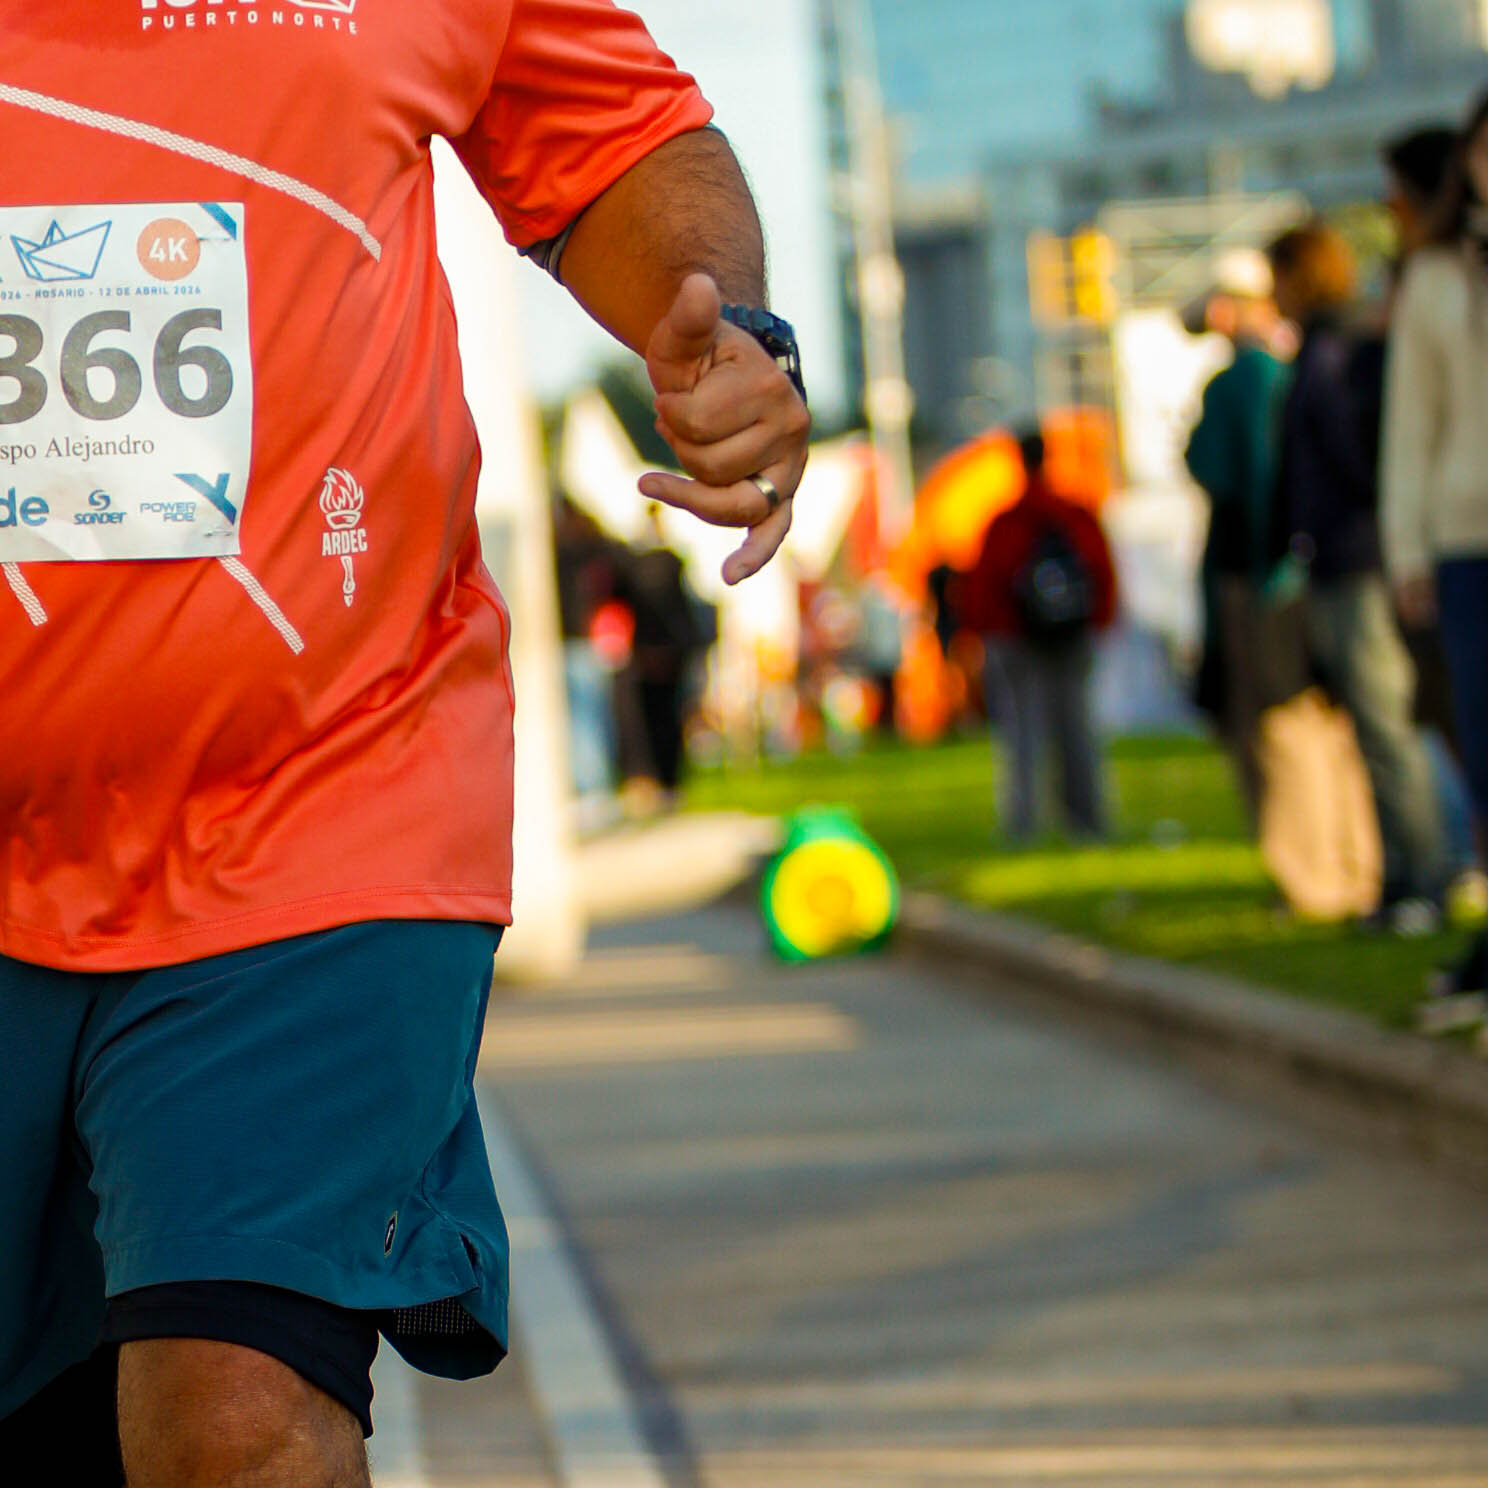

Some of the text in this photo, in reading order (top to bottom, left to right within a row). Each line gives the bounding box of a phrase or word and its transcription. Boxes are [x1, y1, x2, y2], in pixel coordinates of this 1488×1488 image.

[149, 237, 189, 262] 4K
[35, 287, 85, 298] ROSARIO
[99, 287, 112, 297] 12
[116, 286, 131, 296] DE
[135, 285, 169, 296] ABRIL
[45, 435, 155, 462] Alejandro
[140, 502, 197, 513] POWER
[322, 528, 368, 556] ARDEC
